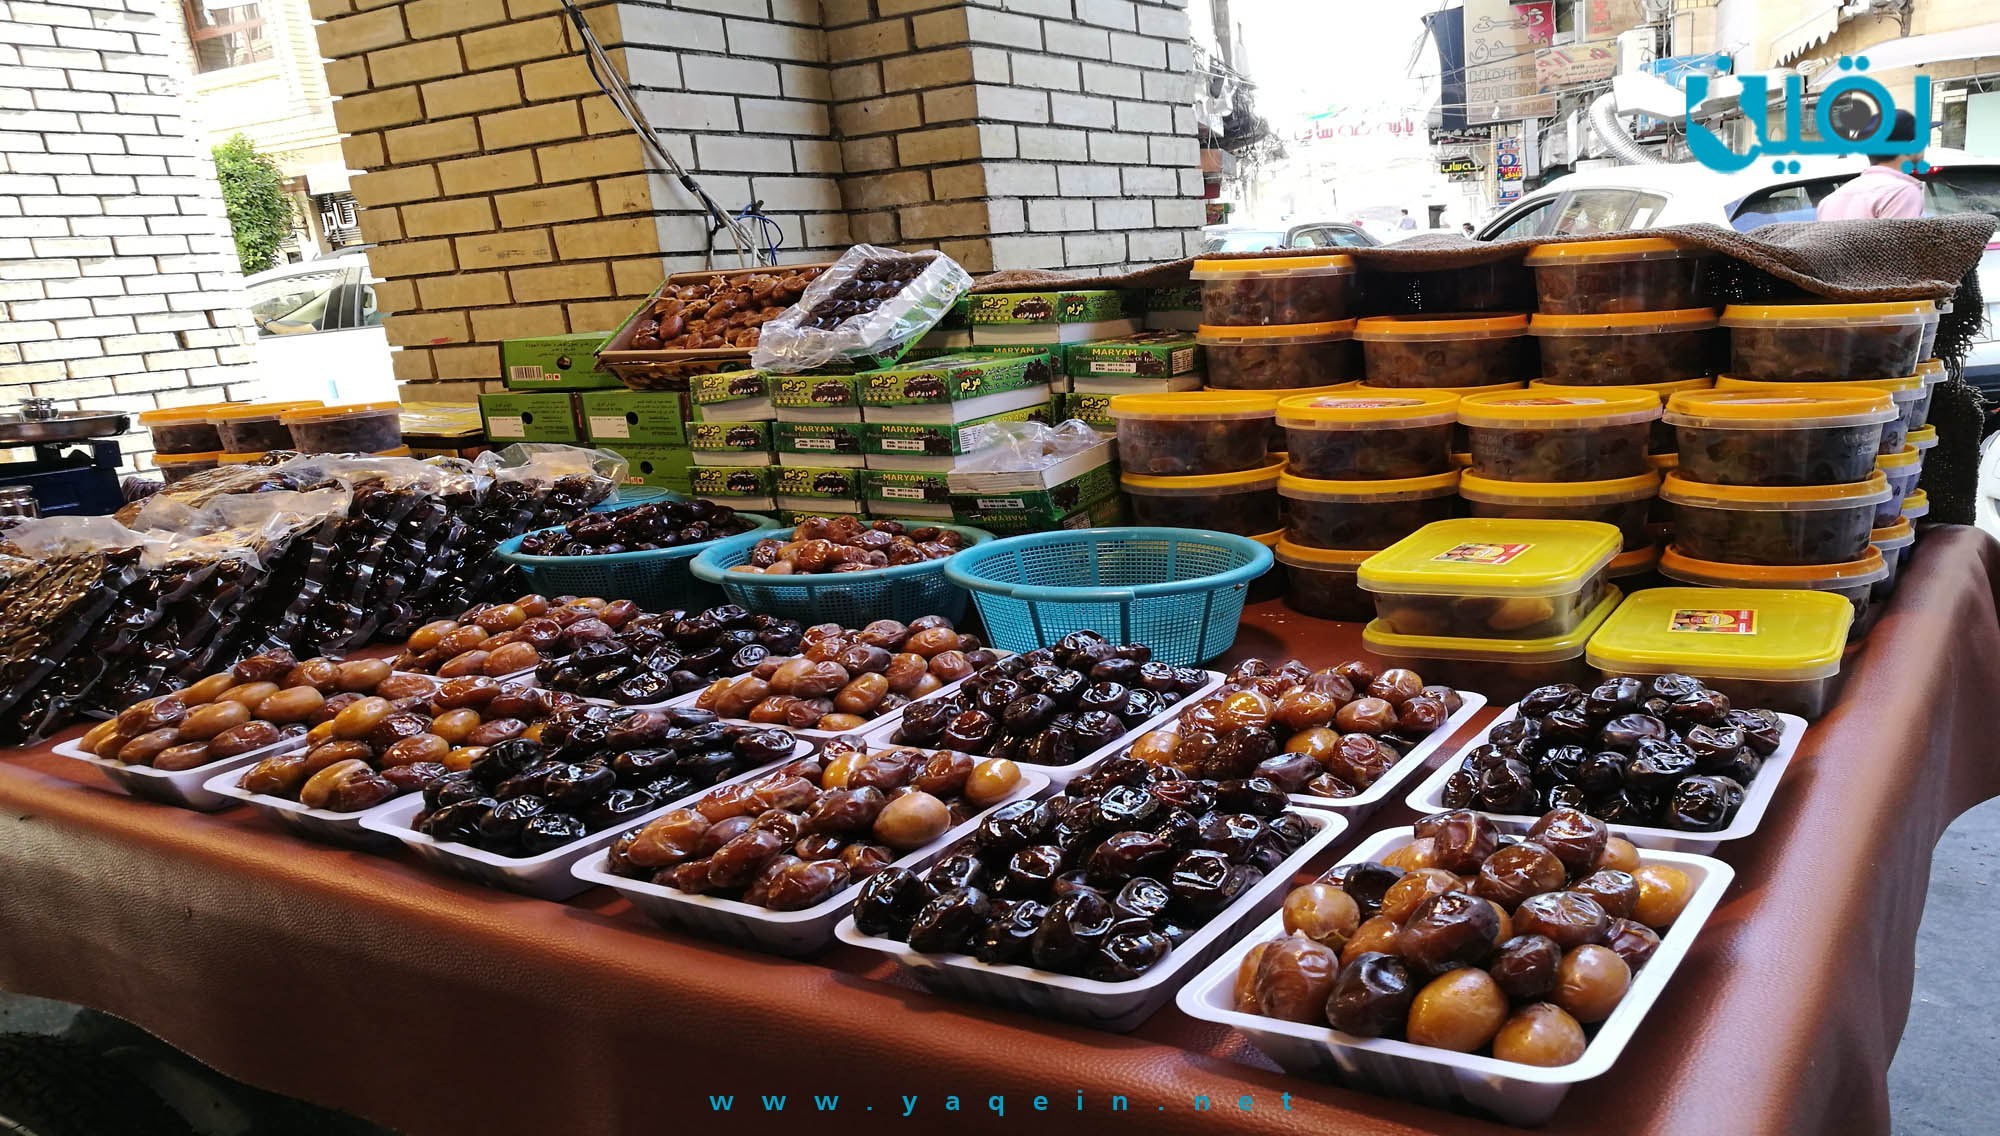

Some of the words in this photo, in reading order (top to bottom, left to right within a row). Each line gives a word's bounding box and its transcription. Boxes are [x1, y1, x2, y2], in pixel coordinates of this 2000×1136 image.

[1470, 65, 1536, 83] HOTE
[1092, 348, 1137, 356] MARYAM
[794, 425, 834, 433] MARYAM
[882, 425, 924, 433] MARYAM
[883, 473, 924, 481] MARYAM
